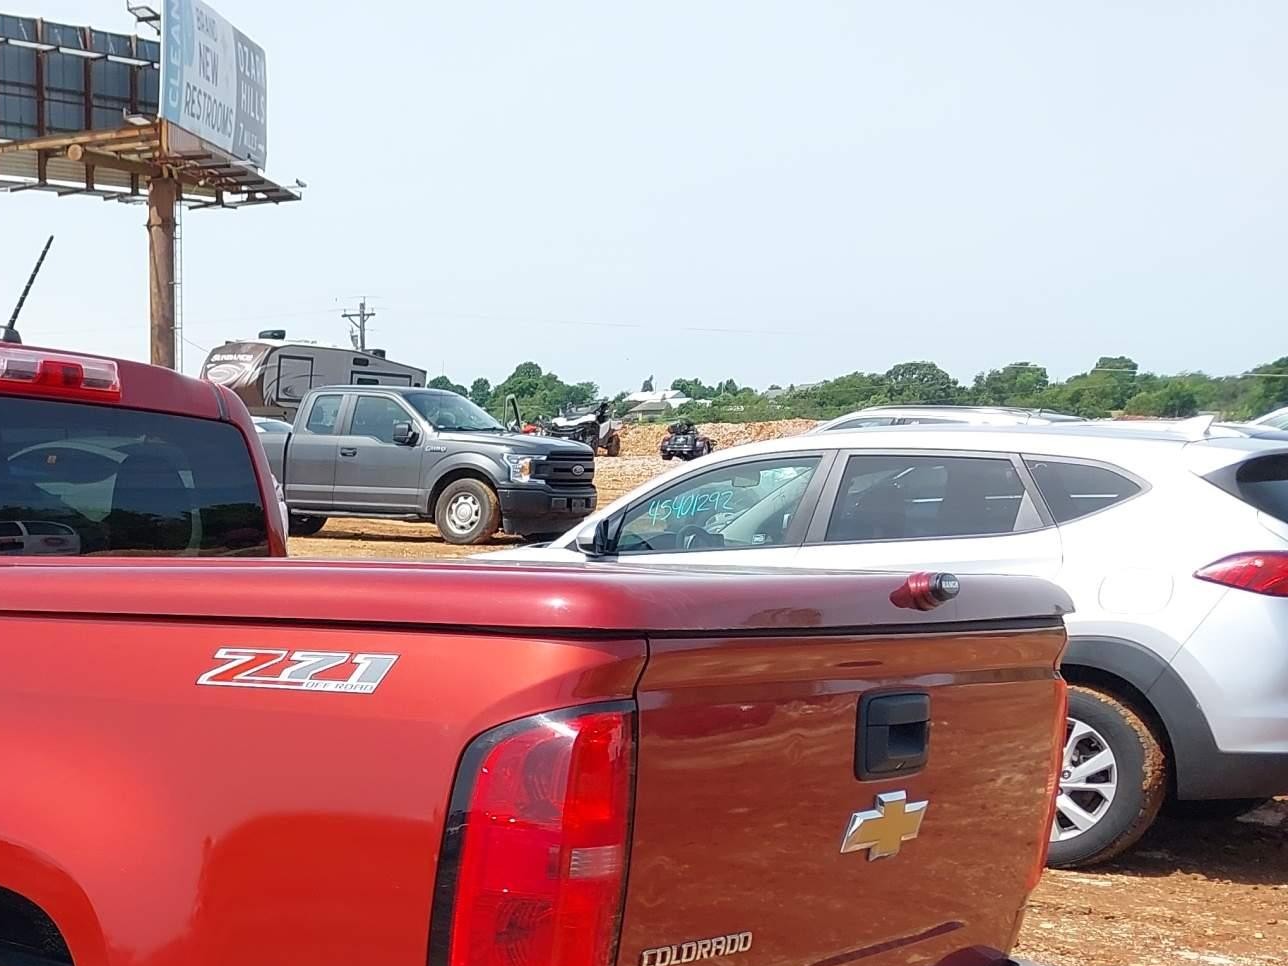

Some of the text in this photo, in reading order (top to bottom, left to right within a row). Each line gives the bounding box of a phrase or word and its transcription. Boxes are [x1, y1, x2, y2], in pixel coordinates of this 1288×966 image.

[195, 7, 217, 43] BRAND
[169, 0, 181, 108] CLEAN
[198, 41, 218, 88] NEW
[184, 81, 234, 139] RESTROOMS
[240, 79, 265, 125] HILLS
[648, 490, 734, 526] 45401292
[196, 647, 400, 692] Z71
[305, 681, 374, 692] OFF ROAD
